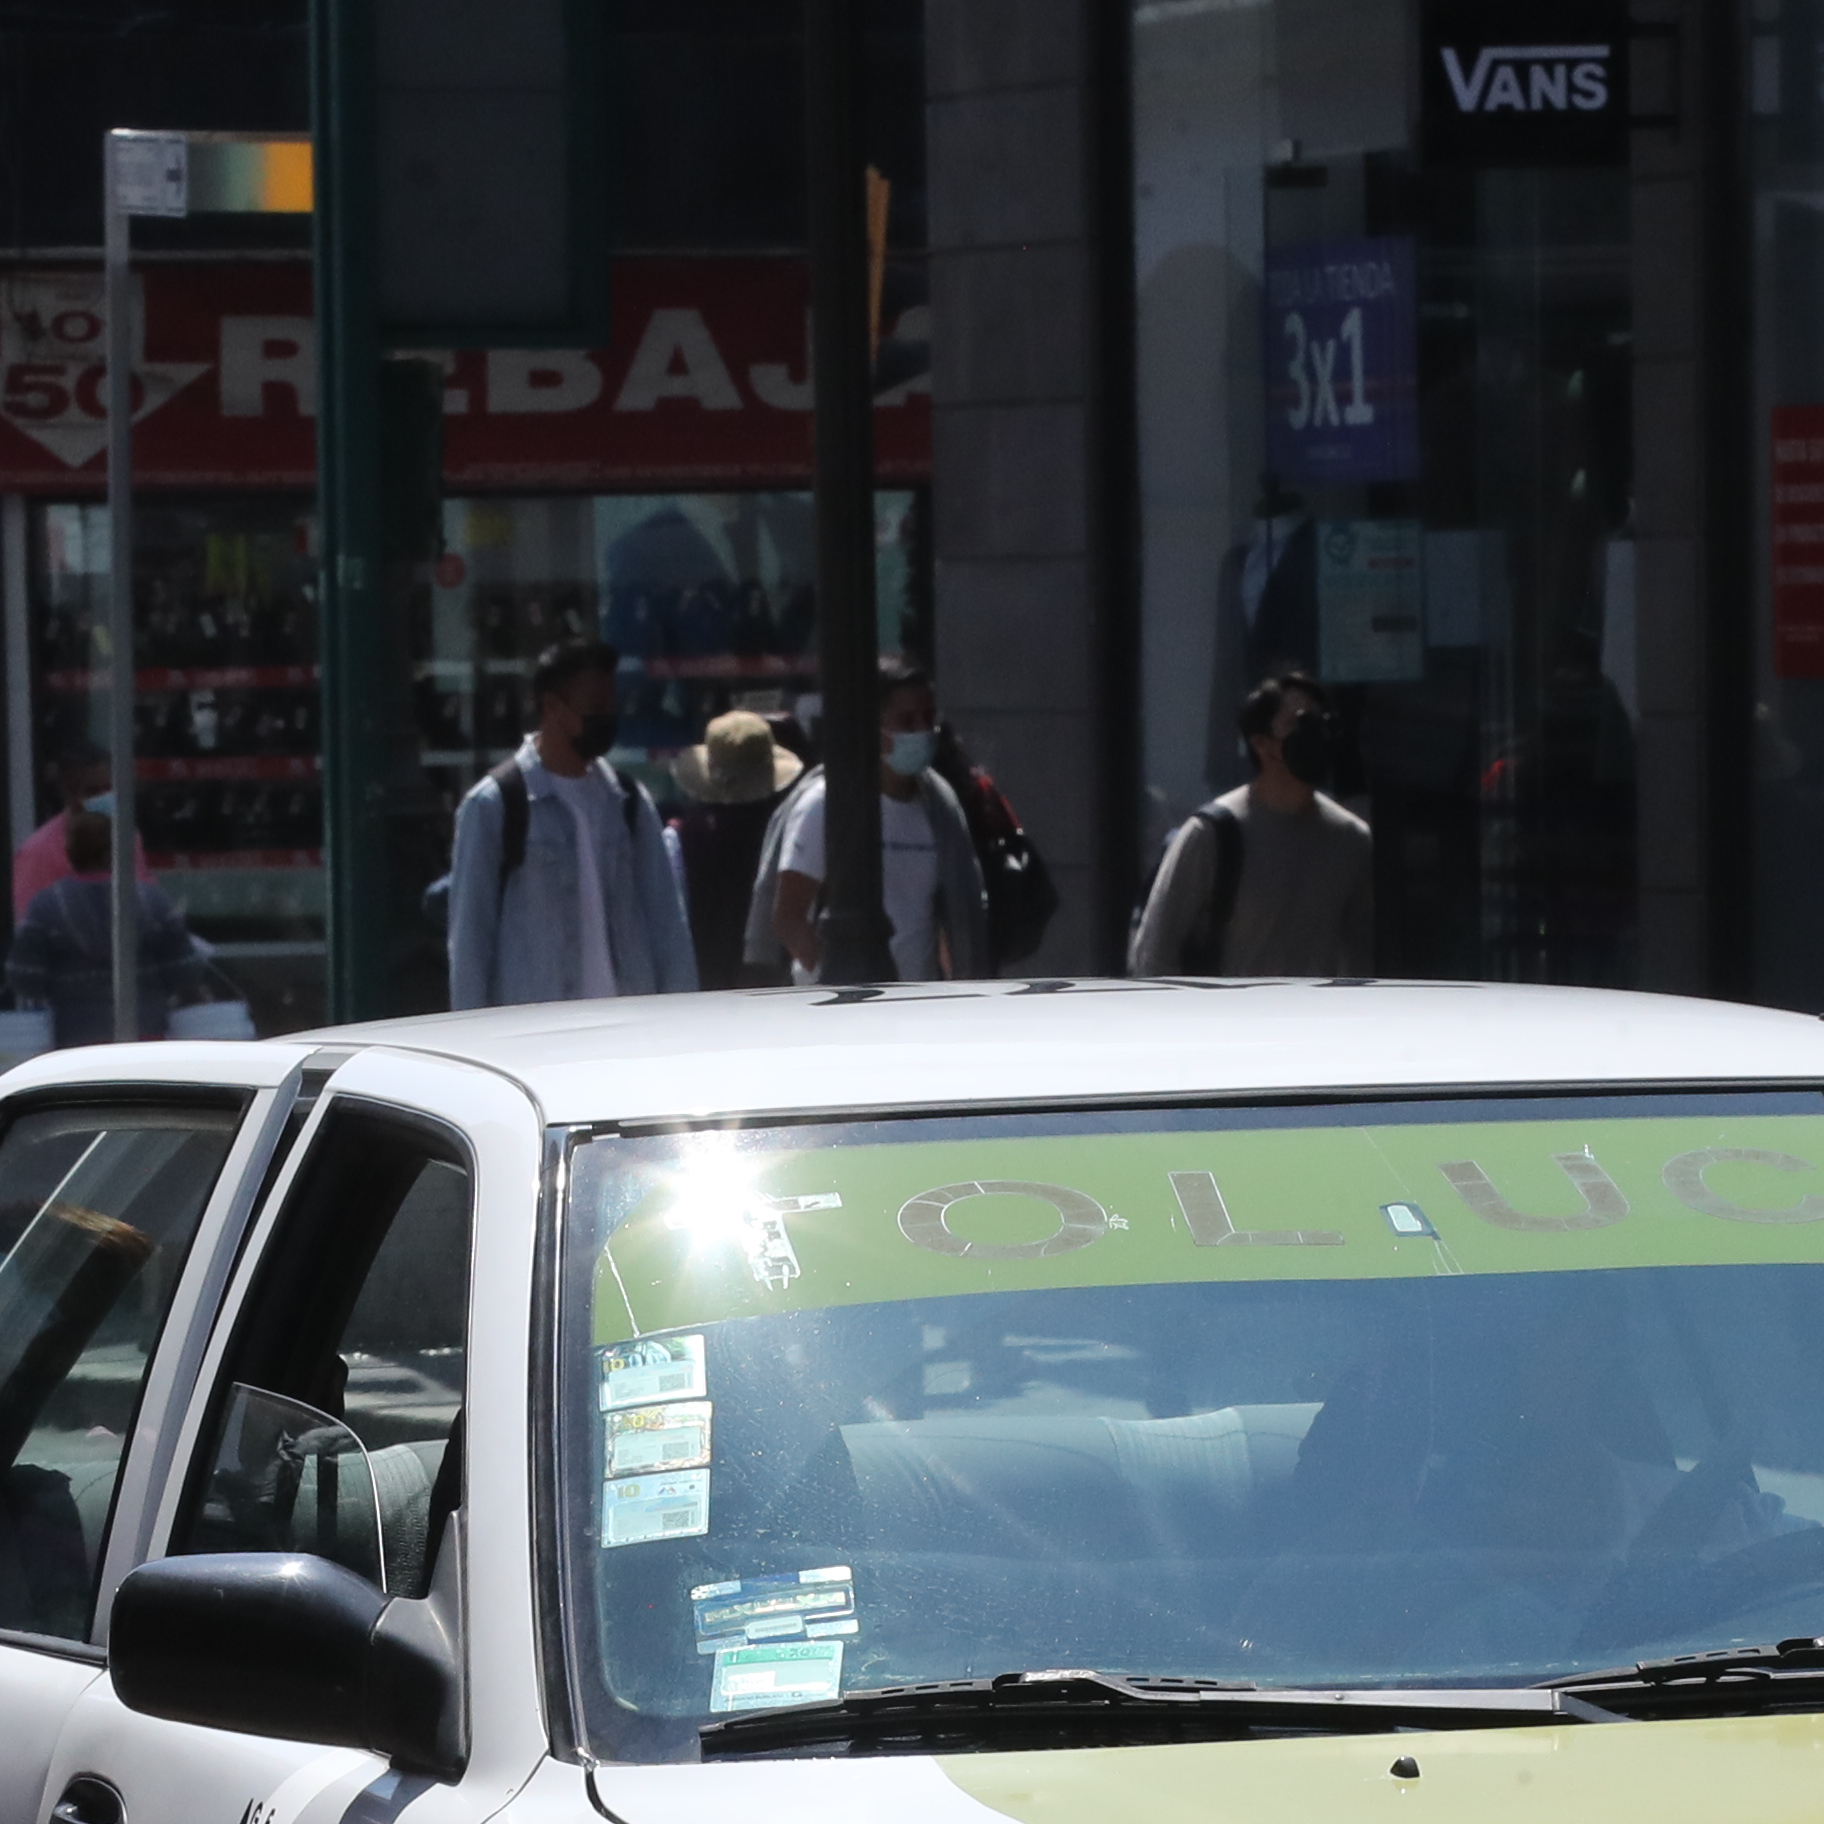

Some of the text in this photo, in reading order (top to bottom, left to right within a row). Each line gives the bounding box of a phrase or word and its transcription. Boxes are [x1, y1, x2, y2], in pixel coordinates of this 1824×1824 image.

[1440, 45, 1610, 113] VANS
[2, 363, 145, 420] 50
[220, 306, 932, 417] RBAJ
[1283, 306, 1376, 430] 3x1
